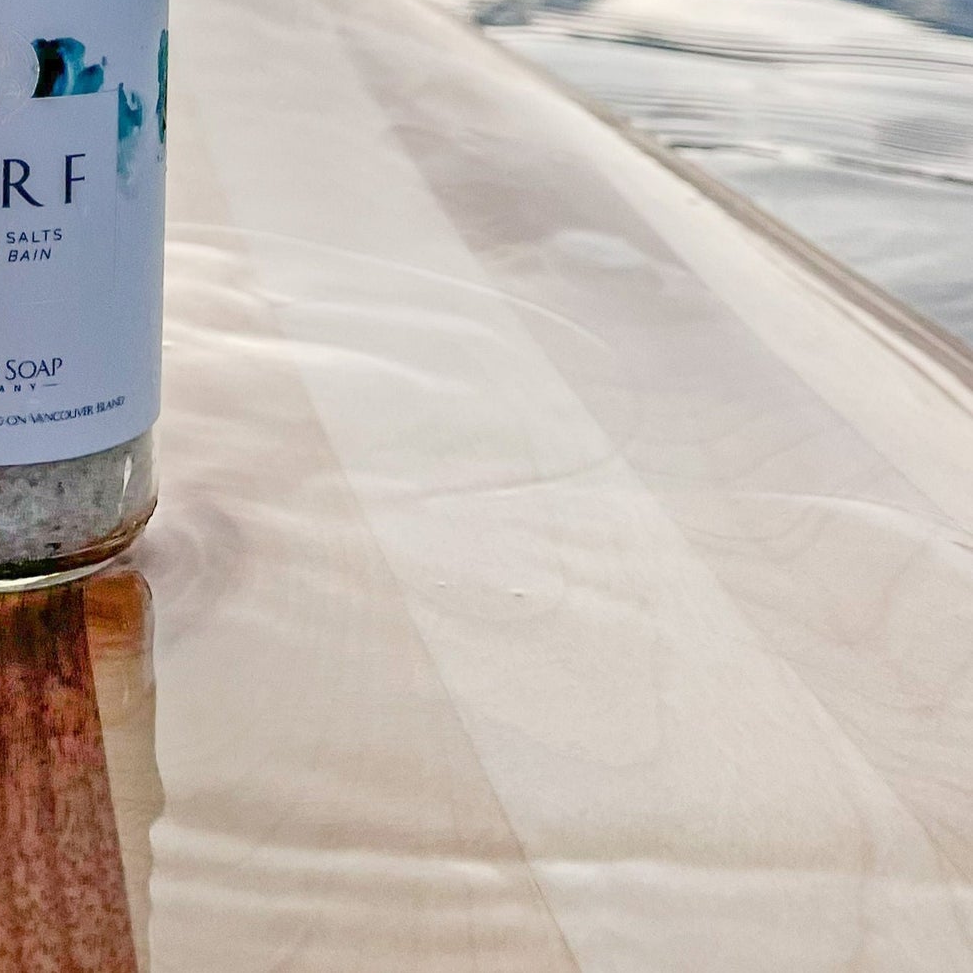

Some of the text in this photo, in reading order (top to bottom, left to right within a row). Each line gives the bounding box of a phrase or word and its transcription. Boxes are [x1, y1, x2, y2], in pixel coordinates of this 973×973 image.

[6, 228, 63, 244] SALTS
[8, 247, 53, 263] BAIN
[5, 357, 63, 380] SOAP
